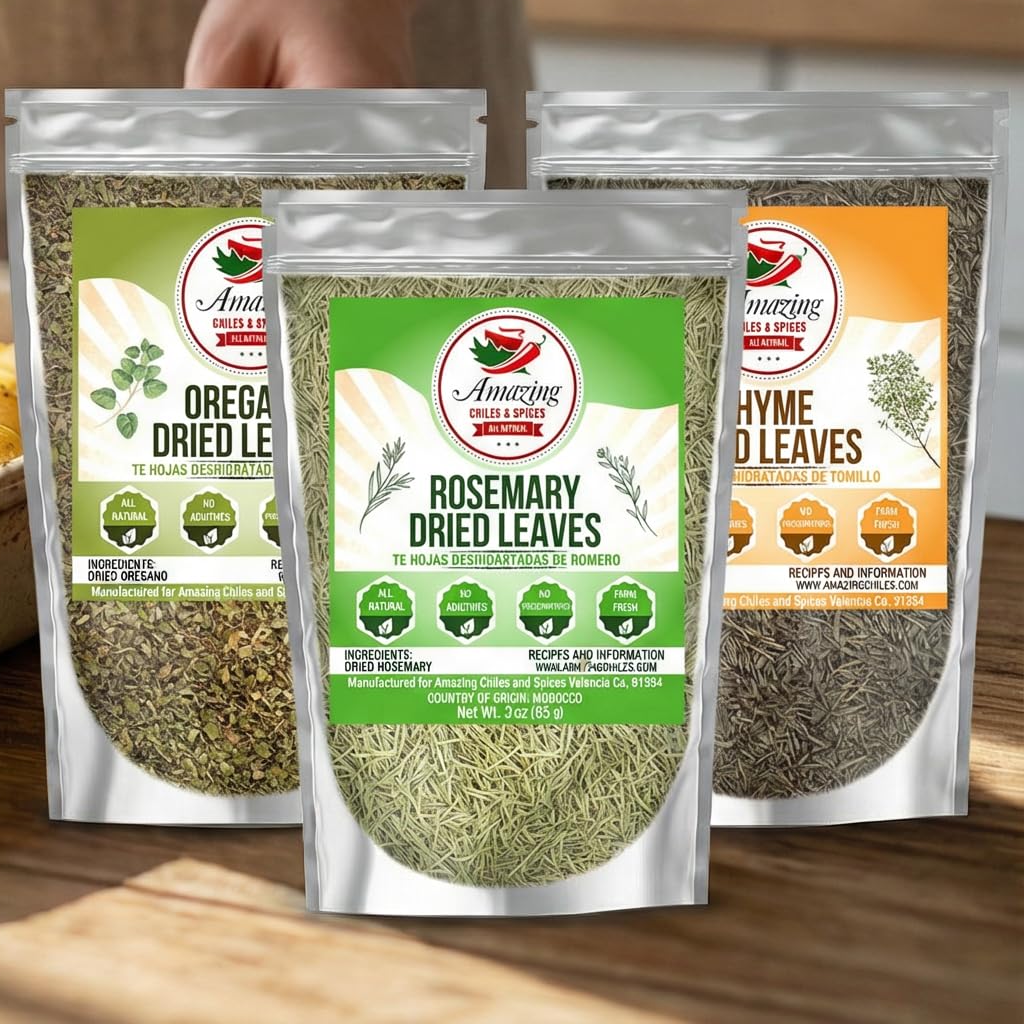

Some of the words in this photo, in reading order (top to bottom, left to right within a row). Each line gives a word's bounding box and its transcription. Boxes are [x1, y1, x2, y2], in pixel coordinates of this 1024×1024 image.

[745, 289, 824, 321] mazing
[451, 376, 563, 408] Amazing
[504, 408, 512, 419] &
[153, 422, 233, 458] DRIED
[759, 428, 863, 465] LEAVES
[132, 463, 146, 476] TE
[149, 463, 187, 476] HOJAS
[830, 470, 881, 483] TOMILLO
[430, 474, 581, 510] ROSEMARY
[120, 499, 136, 508] ALL
[203, 499, 215, 508] NO
[409, 512, 490, 548] DRIED
[498, 512, 602, 548] LEAVES
[392, 553, 406, 566] TE
[410, 553, 448, 566] HOJAS
[833, 567, 854, 578] AND
[857, 567, 927, 578] INFORMATION
[772, 595, 792, 606] and
[512, 677, 531, 688] and
[533, 677, 567, 691] Spices
[457, 706, 478, 719] Net
